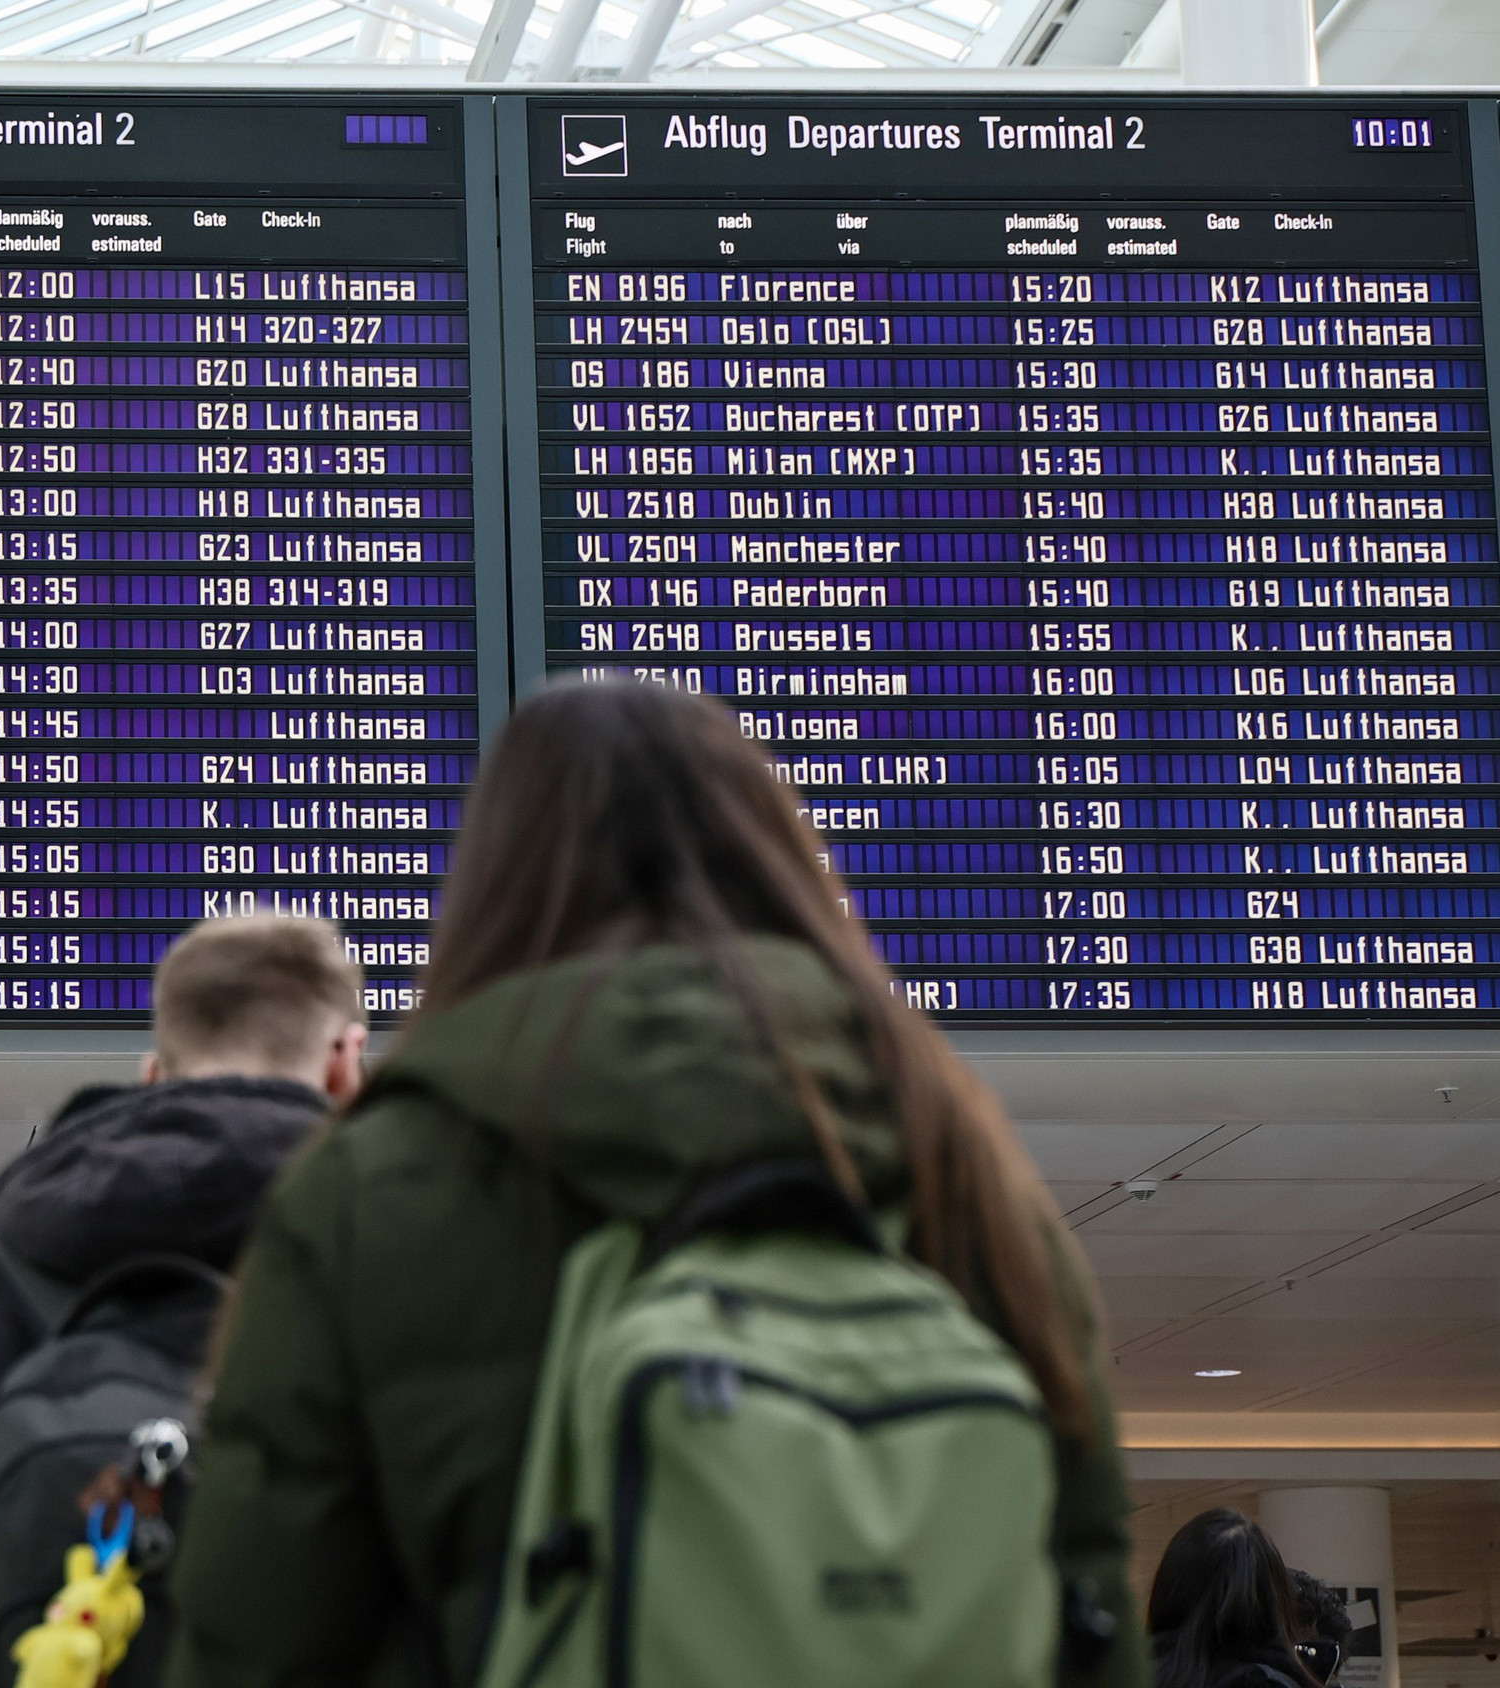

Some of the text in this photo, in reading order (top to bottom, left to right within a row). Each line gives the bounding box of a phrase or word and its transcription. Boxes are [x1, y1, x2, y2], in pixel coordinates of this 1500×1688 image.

[116, 113, 135, 145] 2
[665, 115, 1145, 156] Abflug Departures Terminal 2
[1355, 121, 1430, 146] 10:01
[92, 214, 151, 226] vorauss.
[194, 210, 226, 227] Gate
[262, 211, 320, 227] Check-In
[566, 213, 1332, 233] Flug nach über planmäßig vorauss. Gate Check-In
[92, 236, 161, 252] estimated
[567, 238, 1177, 257] Flight to via scheduled estimated
[569, 275, 1428, 303] EN 8196 Florence 15:20 K12 Lufthansa
[266, 360, 416, 387] Lufthansa
[572, 361, 603, 387] OS
[643, 361, 688, 388] 186
[725, 361, 824, 388] Vienna
[1017, 362, 1096, 388] 15:30
[1284, 363, 1434, 389] Lufthansa
[198, 447, 247, 473] H32
[268, 447, 385, 474] 331-335
[576, 492, 1443, 519] VL 2518 Dublin 15:40 H38 Lufthansa
[269, 535, 421, 562] Lufthansa
[651, 580, 697, 606] 146
[734, 580, 885, 607] Paderborn
[1029, 580, 1108, 607] 15:40
[1298, 580, 1449, 607] Lufthansa
[202, 667, 251, 694] L03
[271, 668, 424, 695] Lufthansa
[740, 713, 1458, 739] Bologna 16:00 K16 Lufthansa
[274, 846, 427, 874] Lufthansa
[1047, 937, 1127, 964] 17:30
[1320, 936, 1473, 963] Lufthansa
[0, 982, 79, 1009] 15:15
